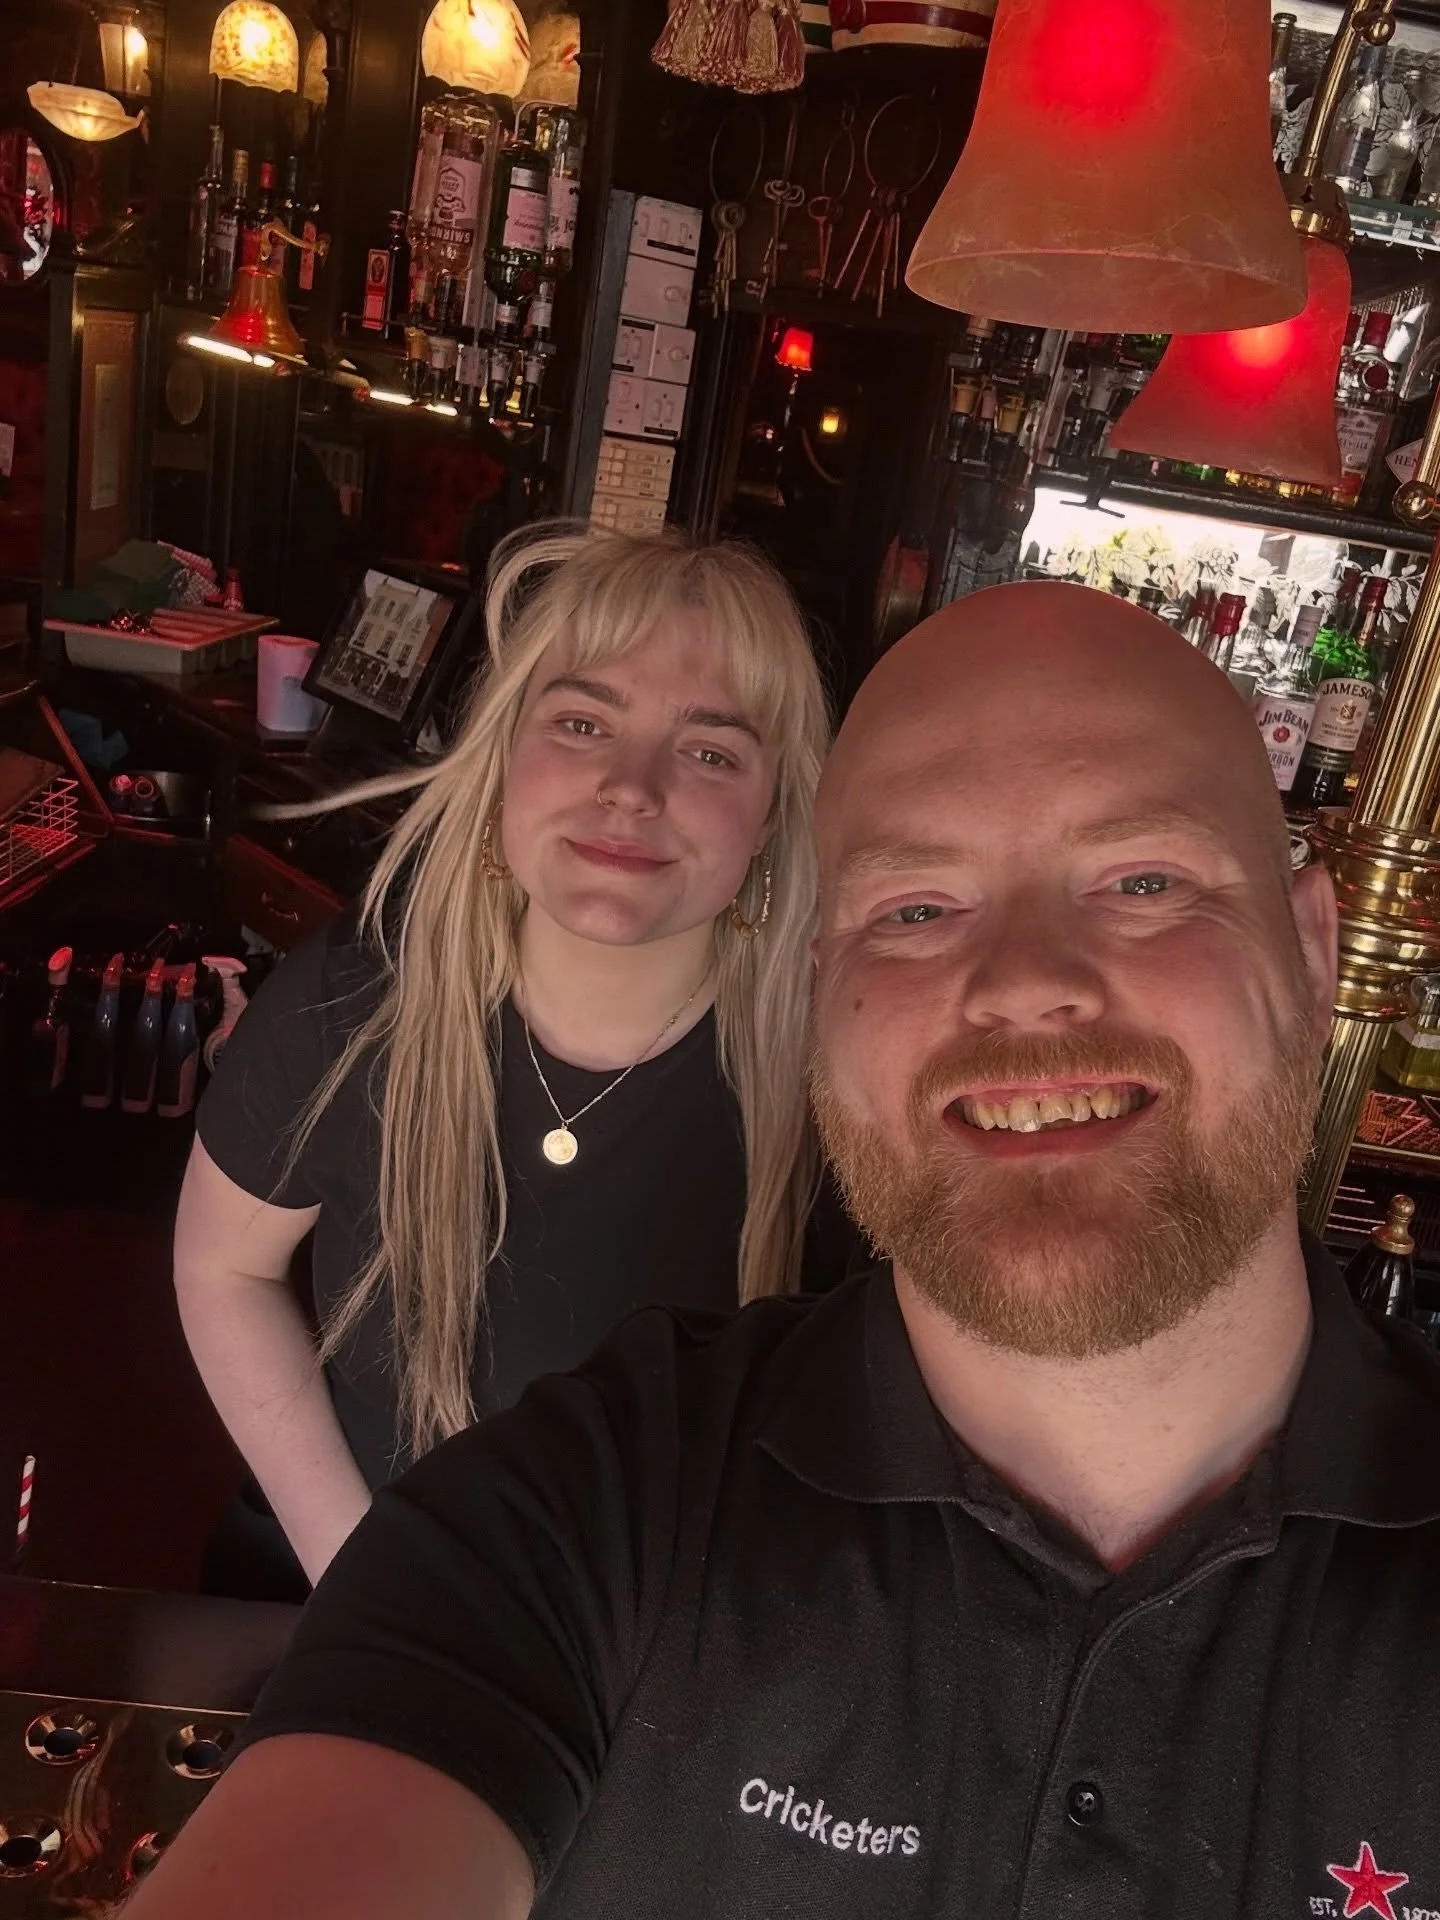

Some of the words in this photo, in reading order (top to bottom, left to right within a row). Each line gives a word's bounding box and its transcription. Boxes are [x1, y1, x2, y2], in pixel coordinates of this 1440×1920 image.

[431, 225, 471, 244] SMIRNO
[1395, 455, 1418, 467] HEN
[1323, 683, 1371, 699] JAMESO
[1259, 711, 1281, 726] JIM
[1282, 709, 1309, 734] BEAM
[1269, 754, 1295, 767] RBON
[739, 1777, 921, 1856] Cricketers
[1309, 1896, 1338, 1918] EST.
